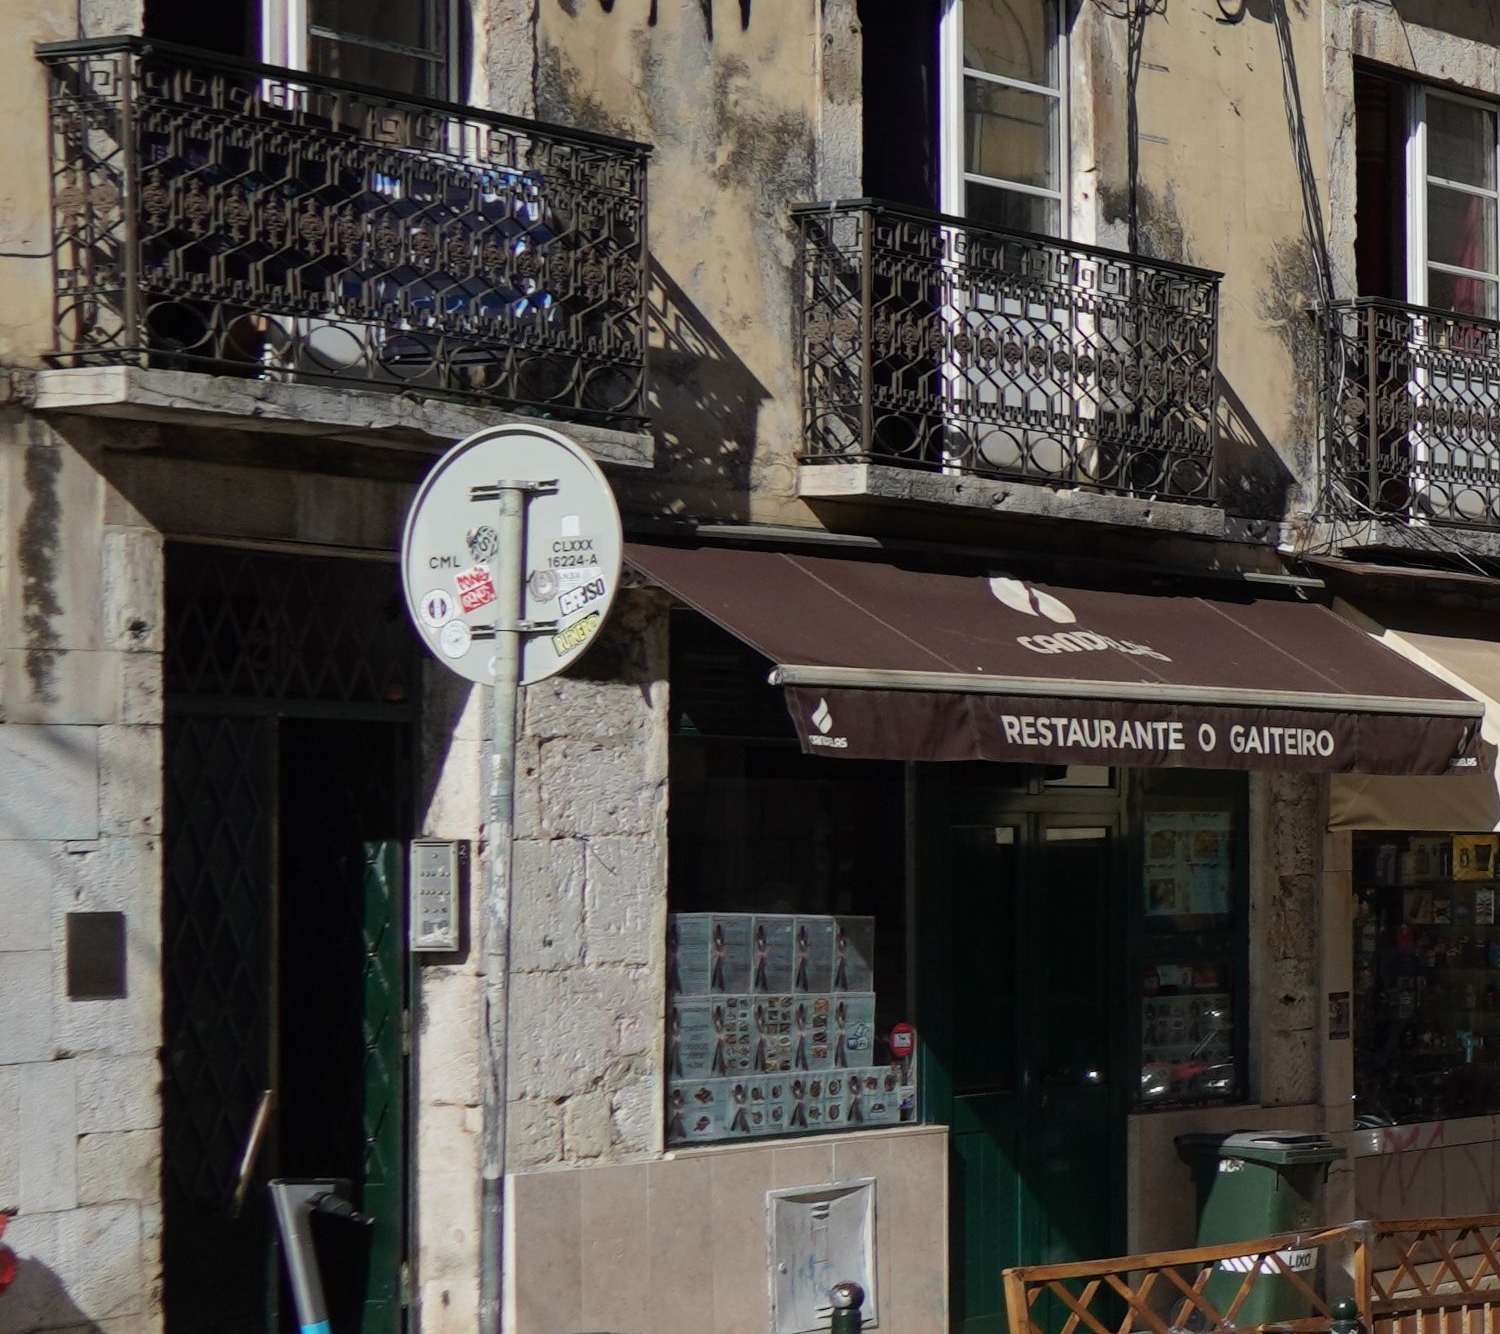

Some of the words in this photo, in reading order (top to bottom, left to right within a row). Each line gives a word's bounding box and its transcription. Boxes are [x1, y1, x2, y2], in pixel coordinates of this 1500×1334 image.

[552, 540, 594, 553] CLXXX
[429, 556, 461, 569] CML
[548, 555, 599, 568] 16224-A
[1001, 715, 1185, 752] RESTAURANTE
[1198, 723, 1217, 752] O
[1230, 724, 1335, 757] GAITEIRO
[1288, 1252, 1311, 1267] LIXO
